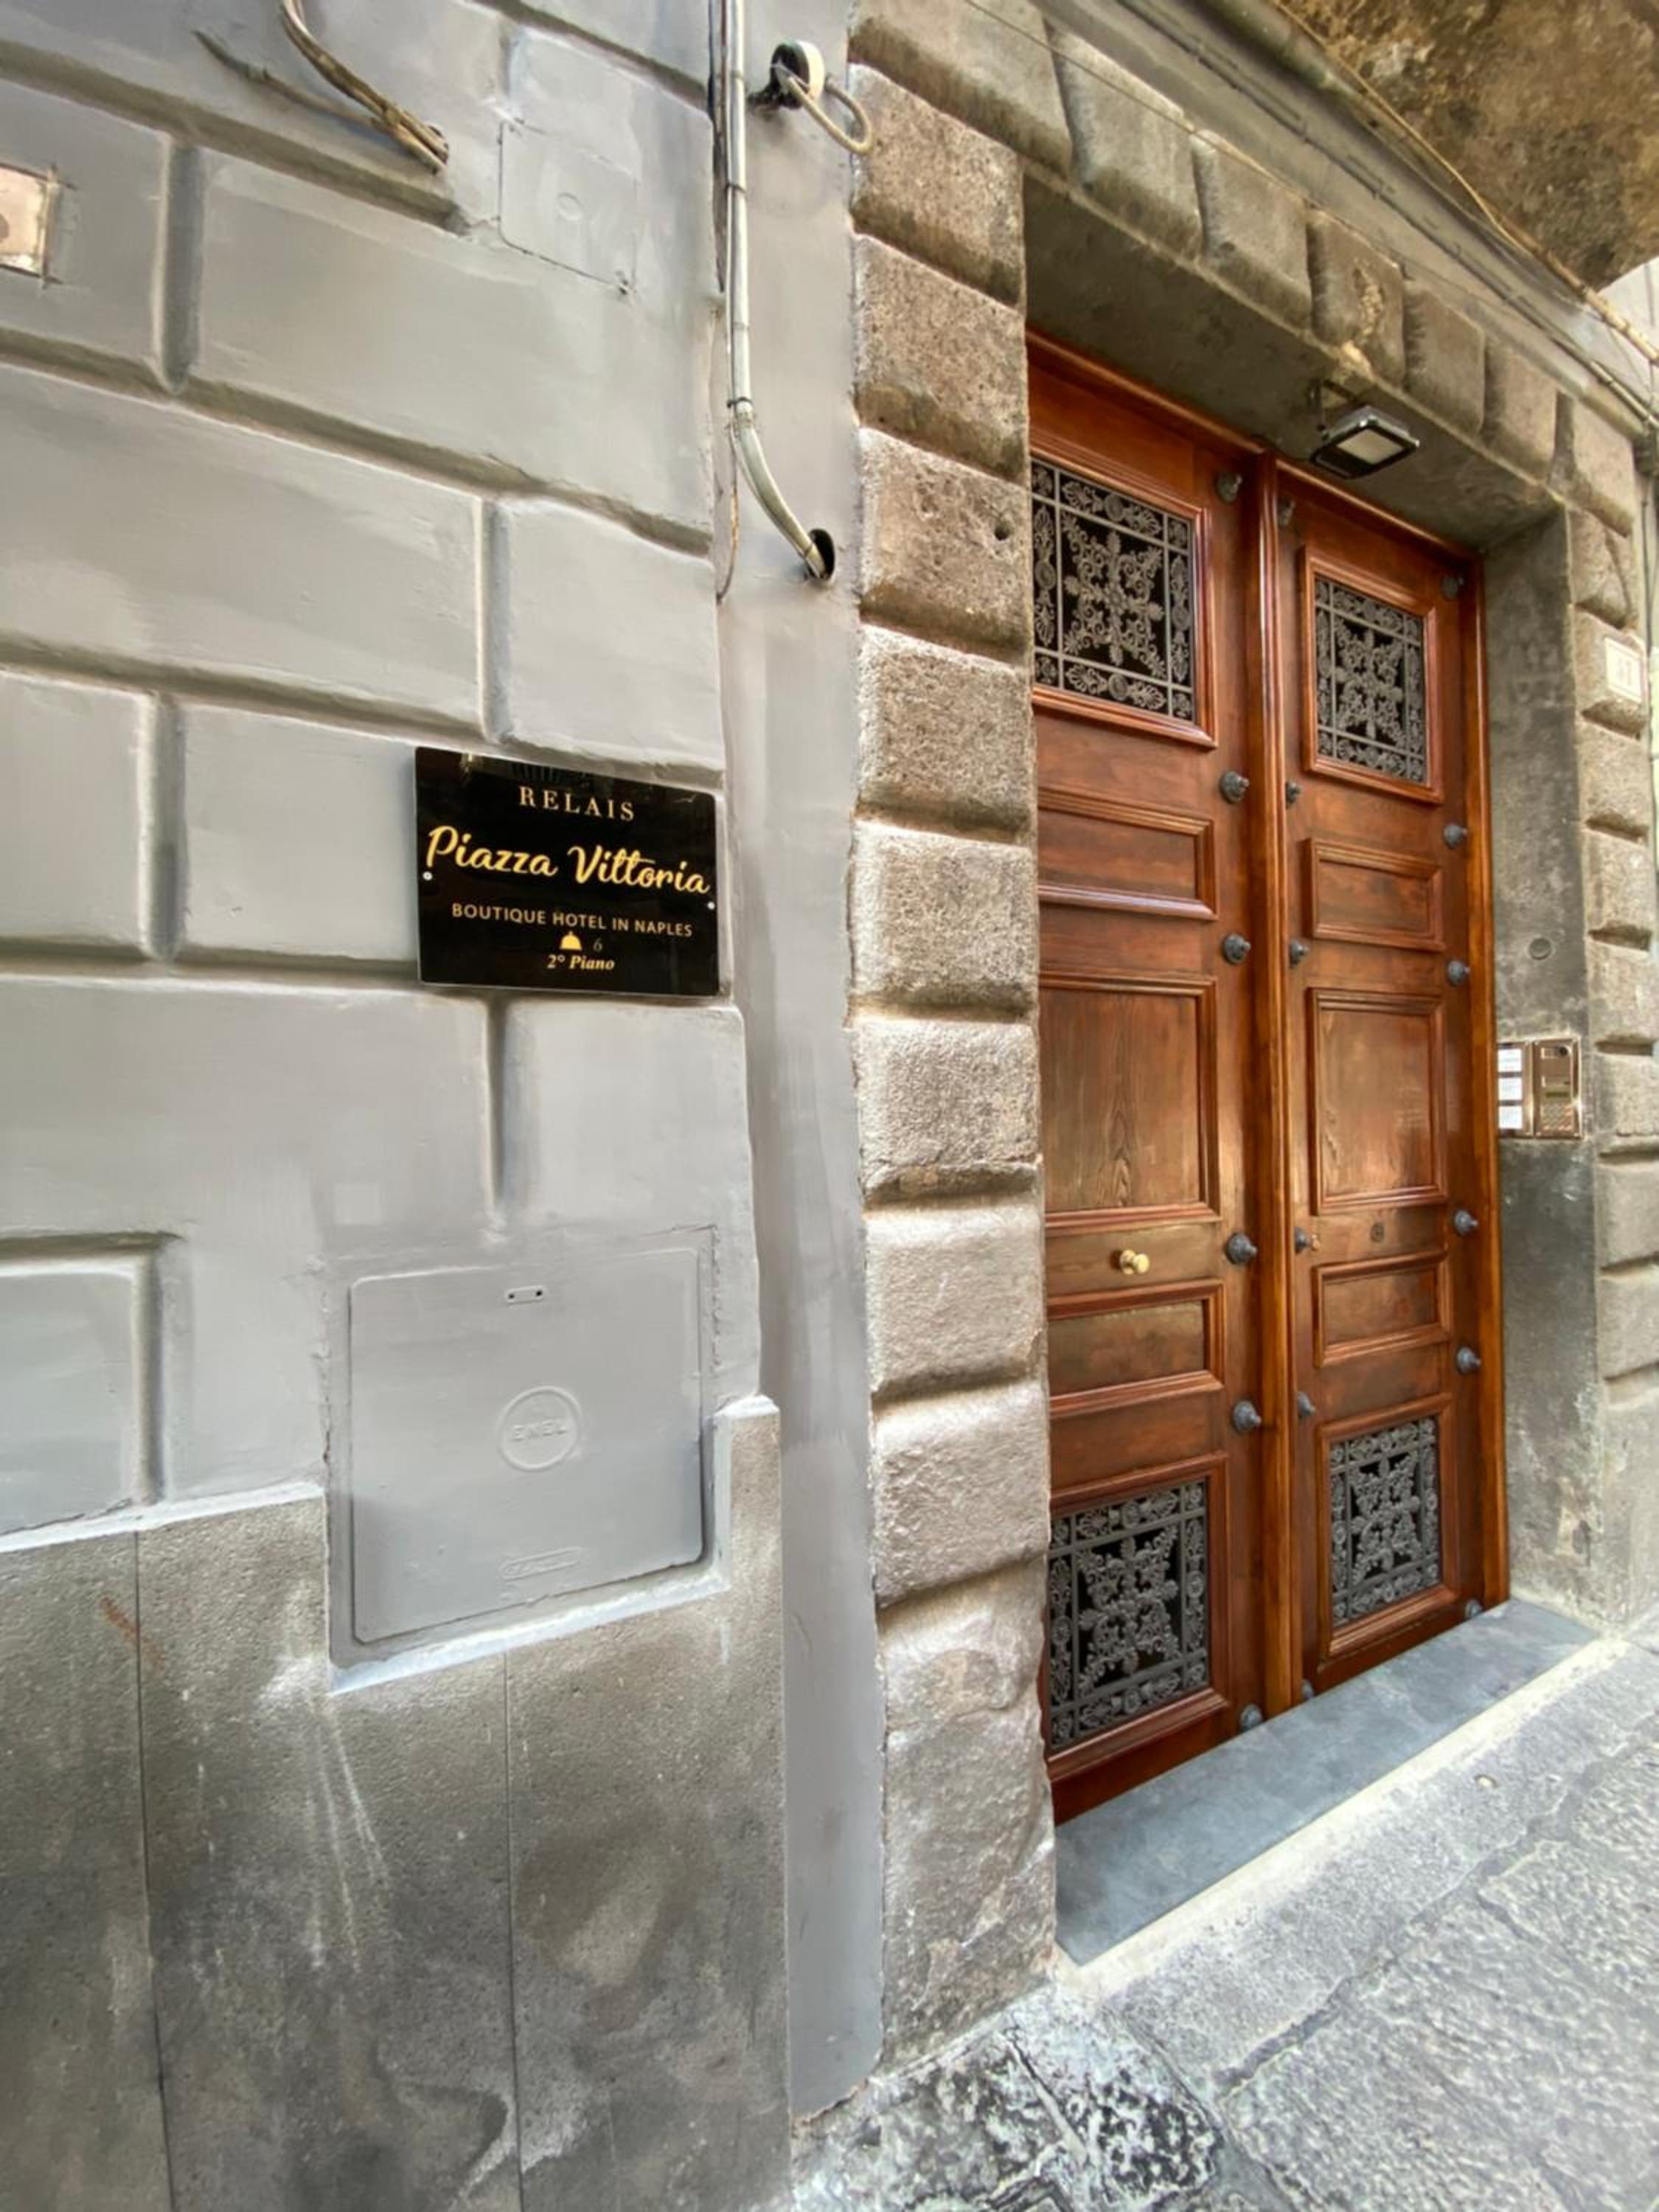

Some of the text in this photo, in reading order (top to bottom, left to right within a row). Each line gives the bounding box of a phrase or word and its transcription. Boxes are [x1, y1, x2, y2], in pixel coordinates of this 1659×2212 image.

[518, 786, 635, 821] RELAIS
[426, 826, 710, 894] Piazza Vittoria
[451, 902, 693, 937] BOUTIQUE HOTEL IN NAPLES
[569, 955, 615, 972] Piano
